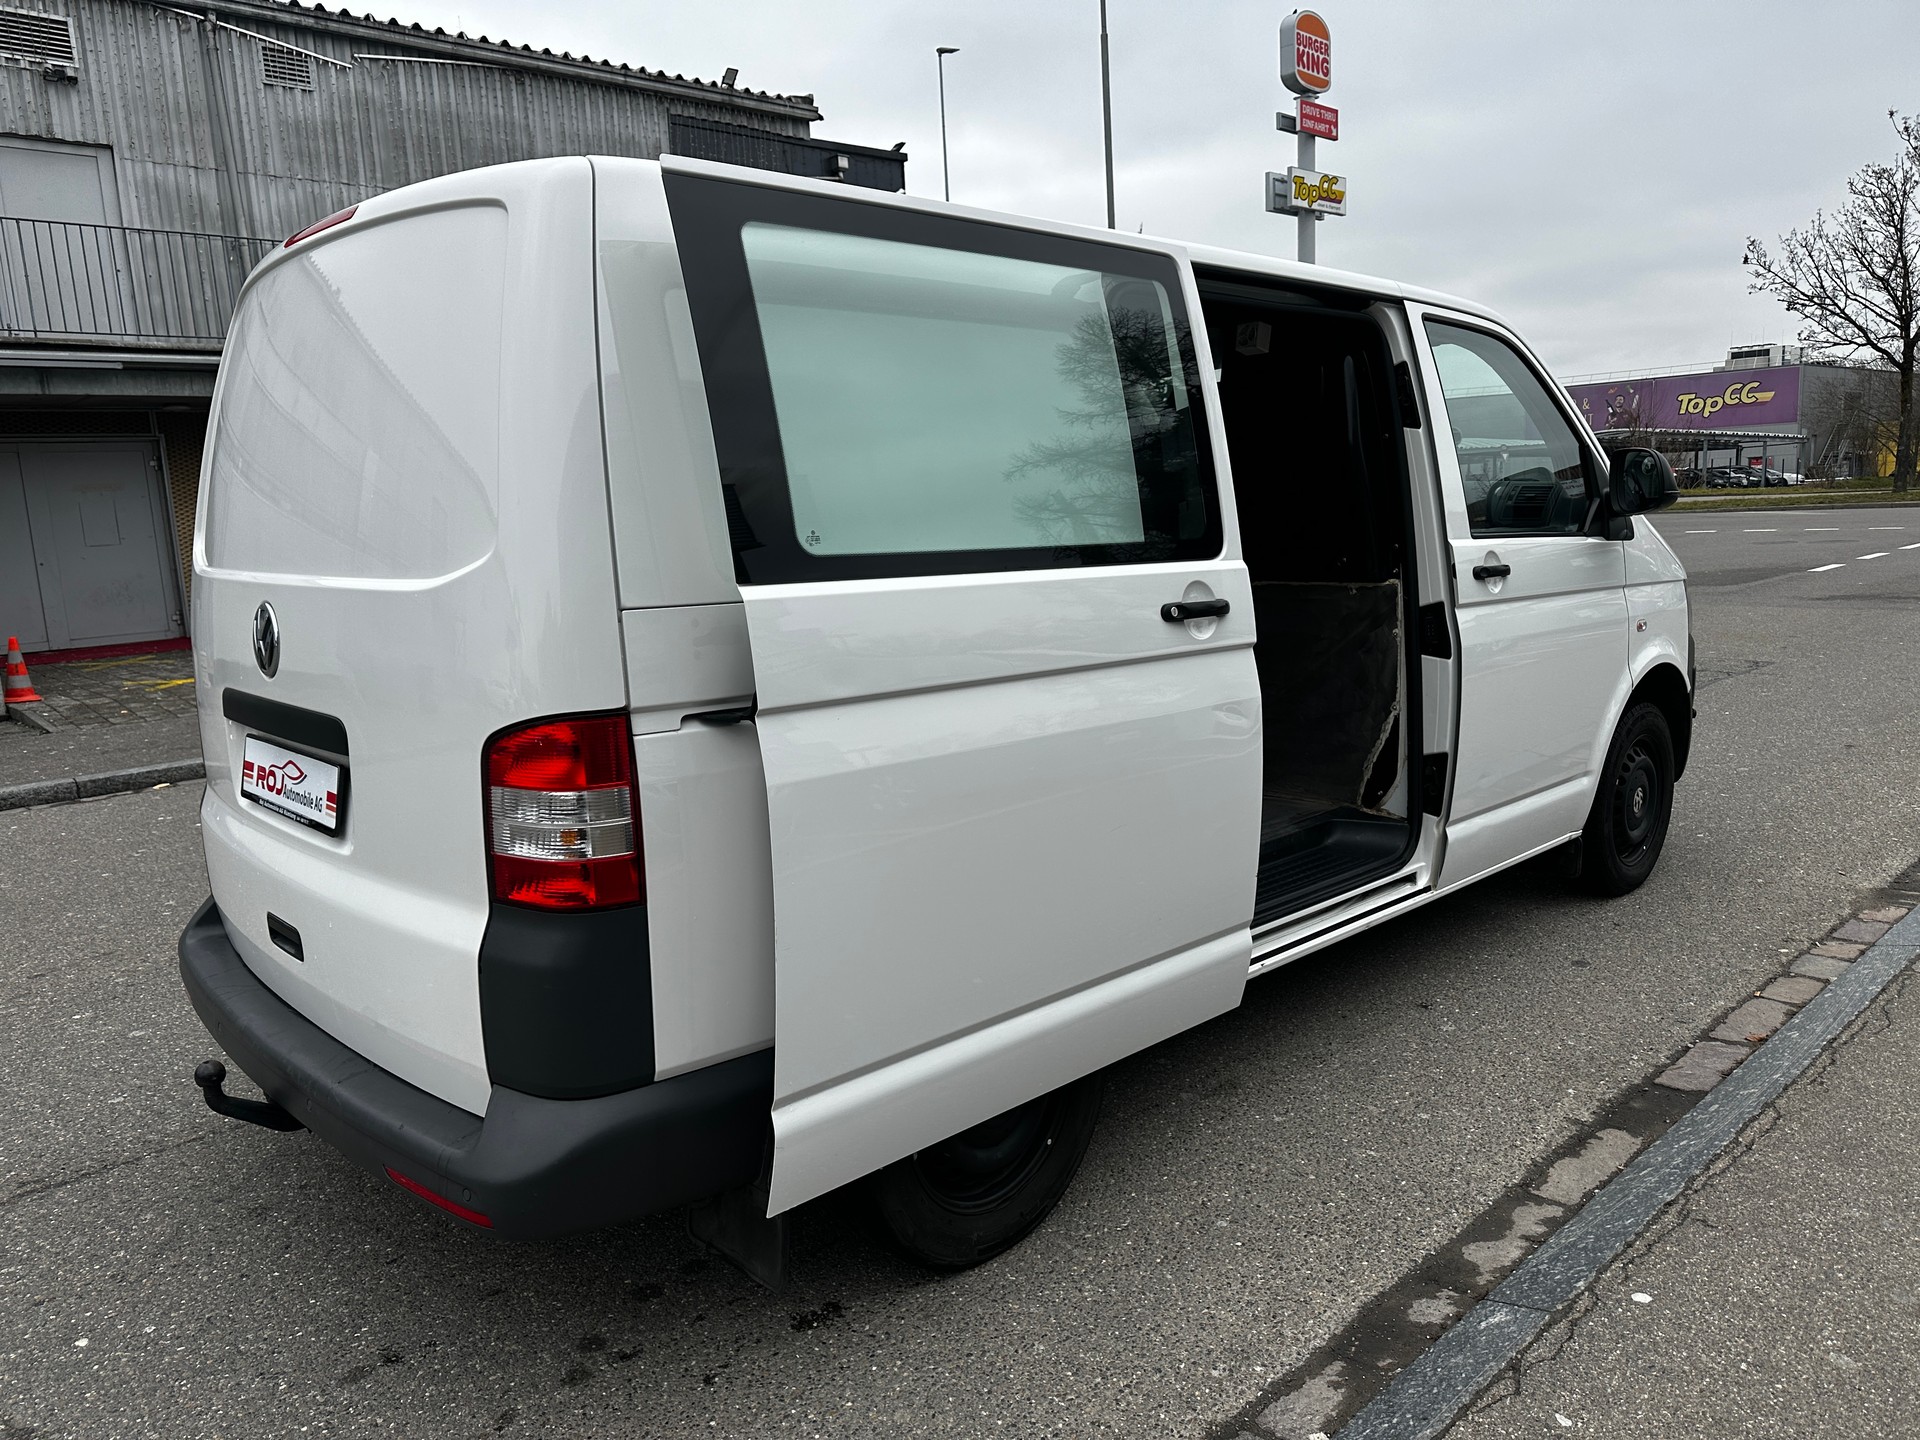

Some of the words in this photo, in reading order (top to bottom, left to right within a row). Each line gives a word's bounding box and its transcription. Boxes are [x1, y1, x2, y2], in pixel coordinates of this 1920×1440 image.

[1296, 31, 1329, 57] BURGER
[1296, 47, 1329, 78] KING
[1302, 104, 1321, 118] DRIVE
[1320, 109, 1337, 122] THRU
[1302, 118, 1330, 133] EINFAHRT
[1293, 174, 1339, 207] TopCC
[1676, 381, 1761, 418] TopCC
[256, 764, 285, 796] ROJ
[283, 783, 314, 810] Automobile
[313, 795, 323, 813] AG
